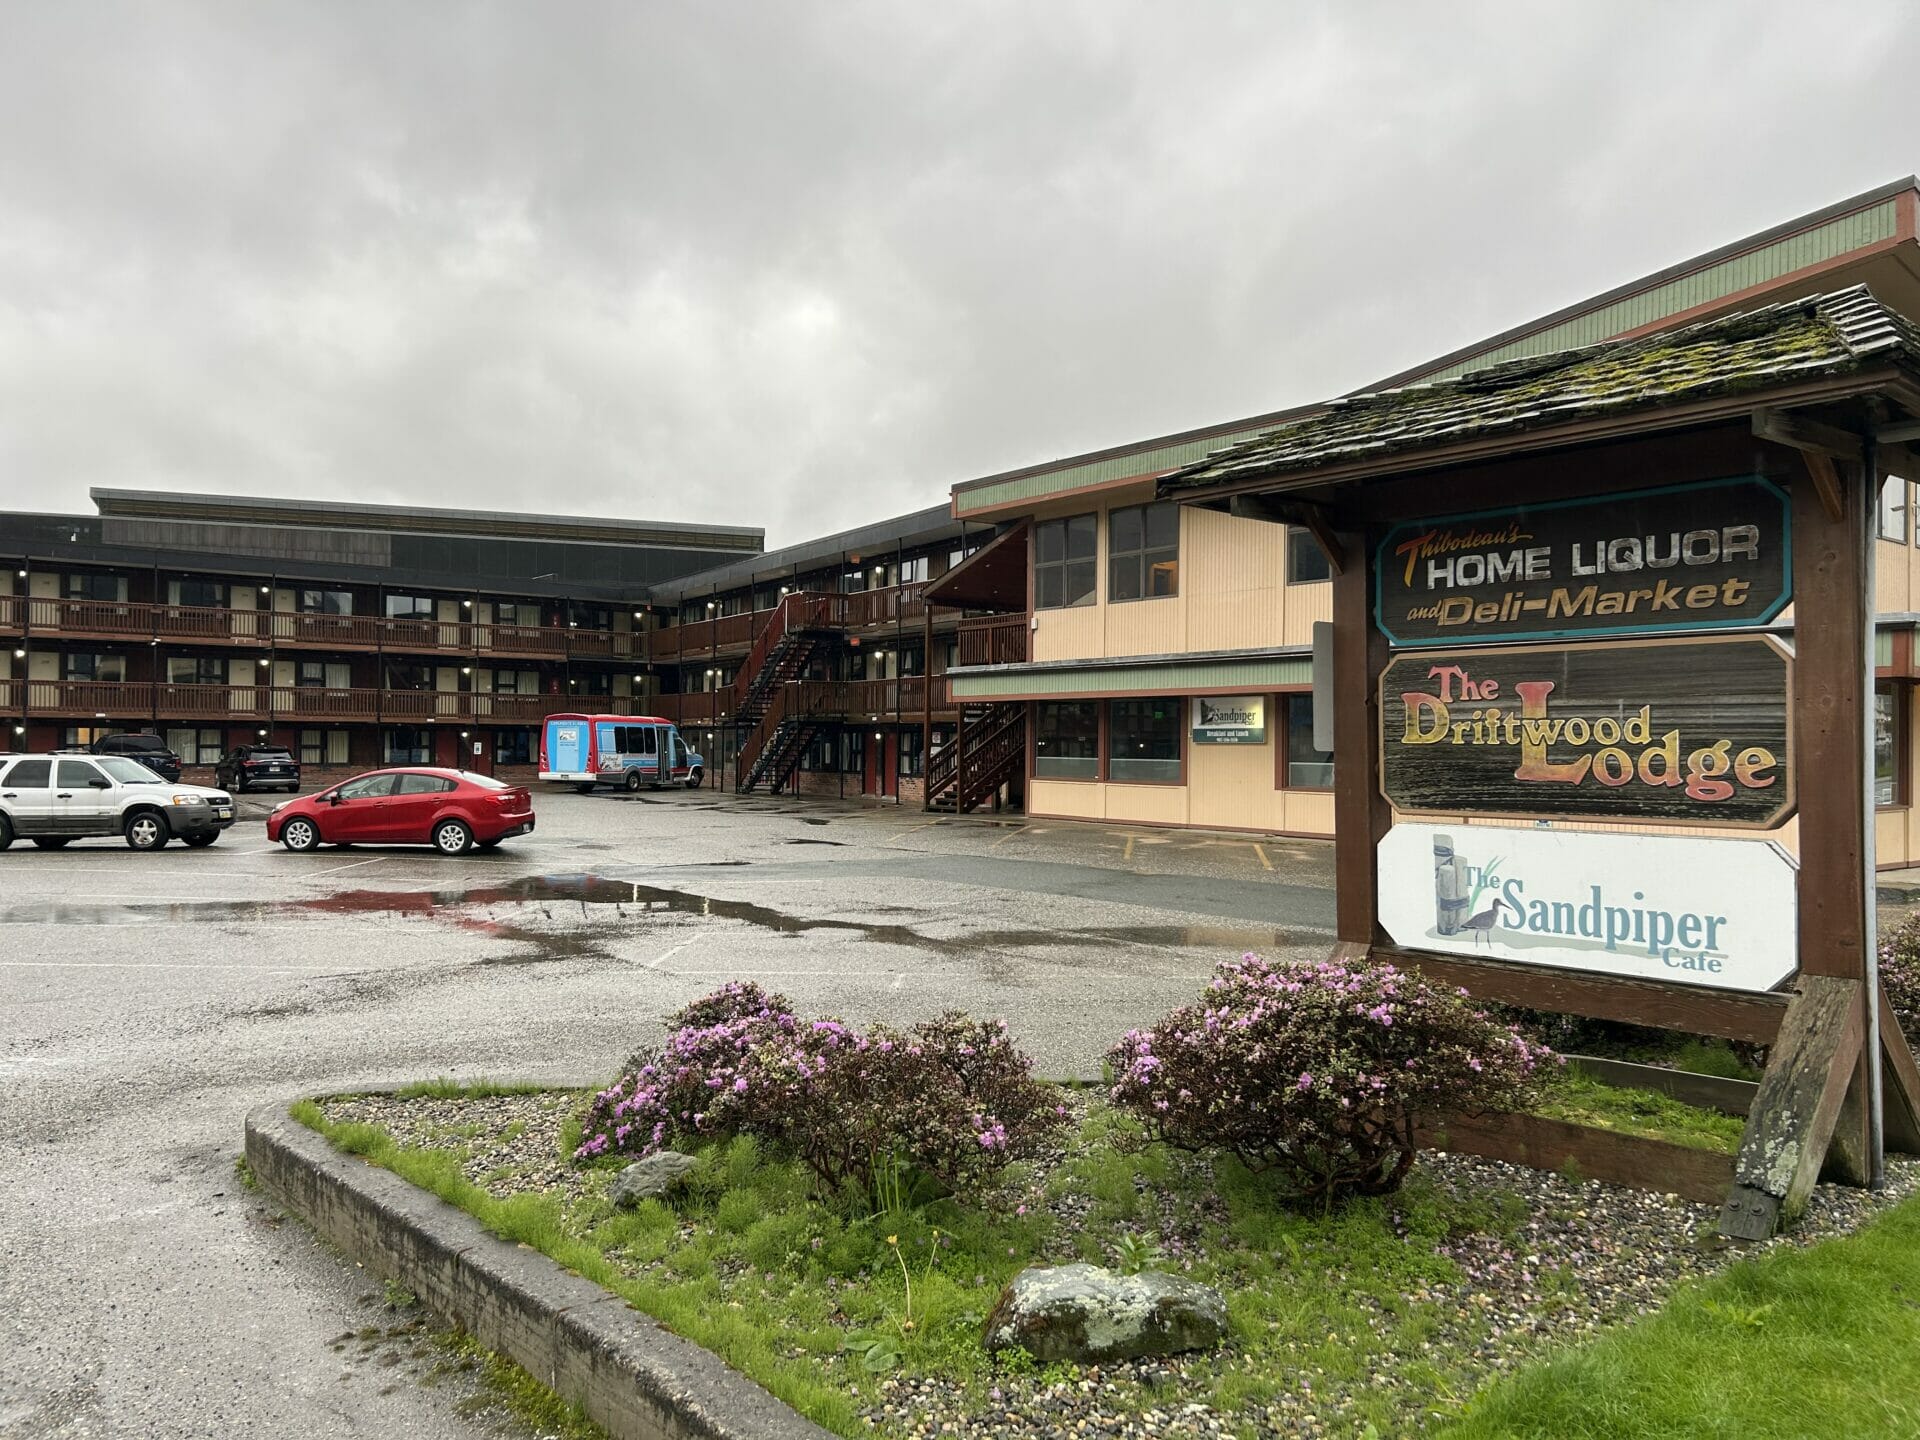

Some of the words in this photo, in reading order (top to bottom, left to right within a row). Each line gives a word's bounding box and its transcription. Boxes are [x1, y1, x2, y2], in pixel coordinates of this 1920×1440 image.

[1396, 521, 1534, 588] Thibodeau's
[1427, 546, 1551, 590] HOME
[1572, 524, 1760, 577] LIQUOR
[1406, 599, 1444, 621] and
[1436, 577, 1751, 627] Deli-Market
[1428, 664, 1500, 703] The
[1213, 707, 1257, 724] Sandpiper
[1401, 692, 1652, 746] Driftwood
[1514, 681, 1777, 801] Lodge
[1463, 866, 1501, 889] The
[1502, 878, 1727, 956] Sandpiper
[1662, 946, 1722, 973] Cafe
